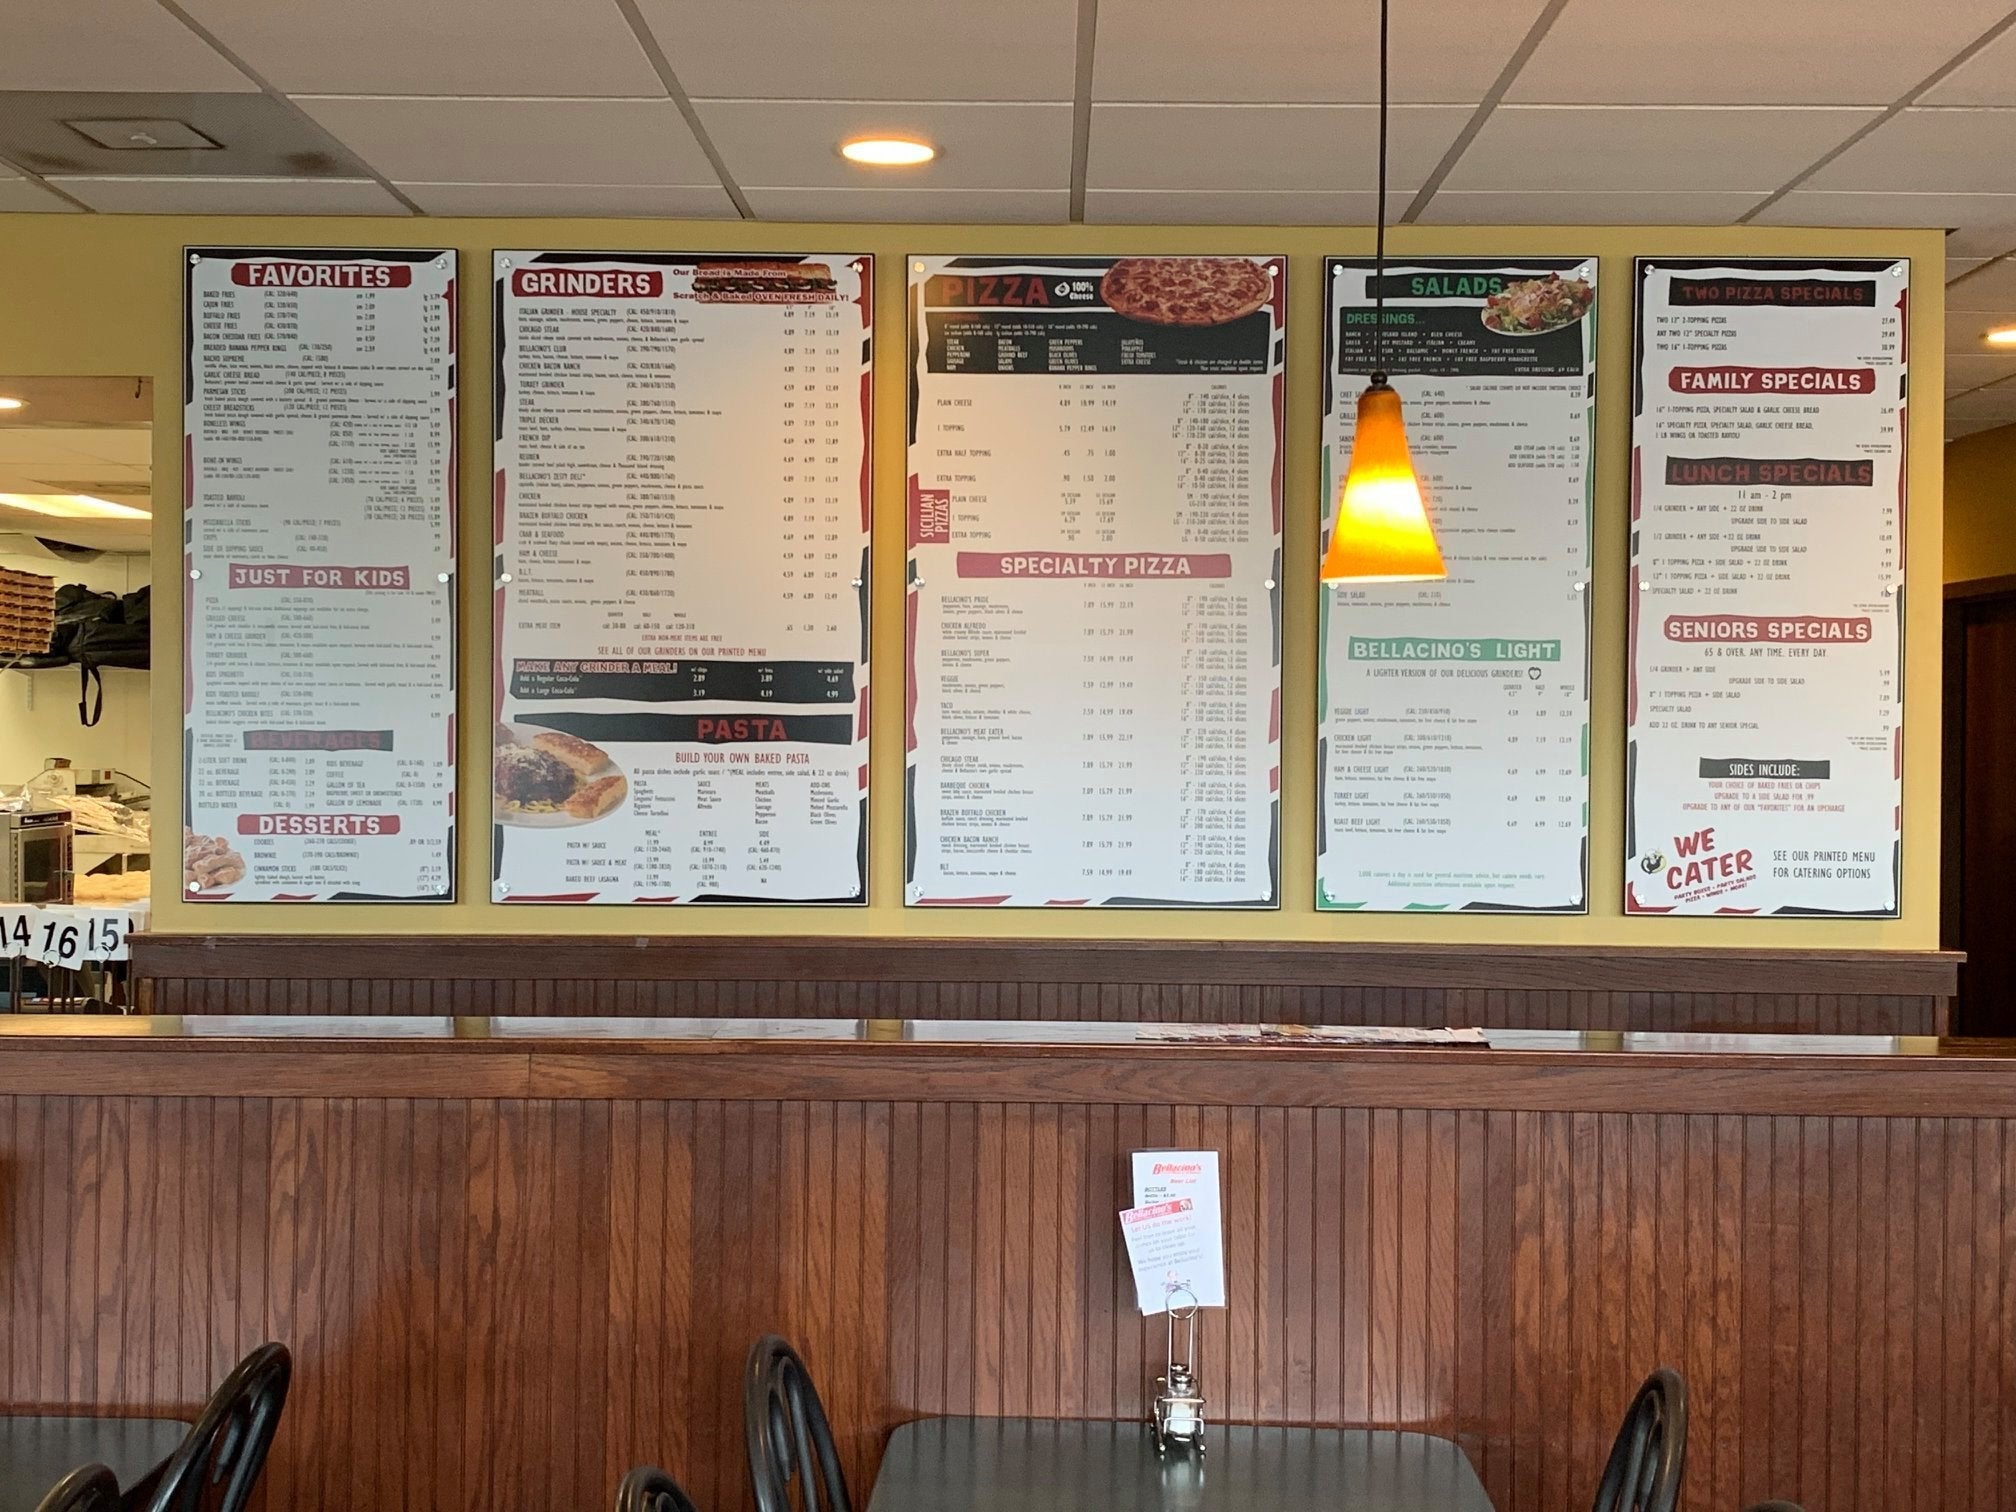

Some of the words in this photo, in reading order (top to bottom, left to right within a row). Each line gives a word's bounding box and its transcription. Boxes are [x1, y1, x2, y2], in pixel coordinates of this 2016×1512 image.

[249, 264, 390, 286] FAVORITES
[692, 269, 720, 277] Bread
[521, 273, 650, 294] GRINDERS
[1071, 282, 1094, 293] 100%
[1411, 277, 1502, 295] SALADS
[203, 291, 220, 299] BAKED
[221, 291, 235, 299] FRIES
[673, 292, 709, 300] Scratch
[712, 292, 720, 300] &
[722, 292, 752, 300] Baked
[783, 293, 814, 301] FRESH
[817, 294, 849, 302] DAILY!
[940, 277, 1049, 305] PIZZA
[1069, 292, 1094, 300] Cheese
[1682, 286, 1720, 299] TWO
[1725, 286, 1773, 300] PIZZA
[1780, 286, 1864, 301] SPECIALS
[203, 301, 220, 309] CAJUN
[221, 301, 234, 309] FRIES
[203, 322, 222, 330] CHEESE
[224, 322, 237, 330] FRIES
[247, 333, 261, 341] FRIES
[223, 371, 241, 379] CHEESE
[243, 371, 260, 379] BREAD
[1681, 373, 1754, 389] FAMILY
[1761, 373, 1861, 390] SPECIALS
[1672, 463, 1749, 481] LUNCH
[1759, 464, 1871, 483] SPECIALS
[1738, 490, 1746, 499] 11
[1772, 490, 1777, 499] 2
[1780, 492, 1792, 501] pm
[920, 493, 934, 538] SICILIAN
[934, 498, 948, 533] PIZZAS
[1000, 557, 1118, 575] SPECIALTY
[1125, 558, 1191, 575] PIZZA
[235, 568, 290, 585] JUST
[303, 569, 343, 586] FOR
[355, 570, 404, 586] KIDS
[1669, 621, 1758, 638] SENIORS
[1768, 622, 1868, 639] SPECIALS
[598, 646, 609, 656] SEE
[612, 646, 624, 656] ALL
[626, 646, 634, 656] OF
[637, 646, 651, 657] OUR
[653, 646, 686, 657] GRINDERS
[689, 647, 698, 657] ON
[701, 647, 715, 657] OUR
[718, 647, 745, 657] PRINTED
[748, 648, 767, 657] MENU
[1353, 642, 1482, 658] BELLACINO'S
[1496, 642, 1555, 659] LIGHT
[1704, 648, 1714, 657] 65
[1717, 648, 1722, 657] &
[1750, 648, 1763, 657] ANY
[1788, 648, 1809, 657] EVERY
[515, 661, 550, 673] MAKE
[553, 661, 579, 673] ANY
[581, 662, 629, 674] GRINDER
[630, 663, 641, 673] A
[642, 663, 678, 674] MEAL!
[1366, 668, 1371, 677] A
[1373, 668, 1399, 678] LIGHTER
[1401, 668, 1427, 678] VERSION
[1429, 668, 1437, 678] OF
[1440, 668, 1454, 678] OUR
[1457, 668, 1489, 678] DELICIOUS
[1491, 669, 1523, 678] GRINDERS!
[697, 719, 787, 740] PASTA
[675, 752, 700, 764] BUILD
[703, 753, 726, 764] YOUR
[729, 753, 750, 764] OWN
[754, 753, 782, 764] BAKED
[786, 753, 810, 764] PASTA
[1729, 763, 1754, 776] SIDES
[1758, 764, 1800, 776] INCLUDE:
[940, 782, 967, 790] BARBEQUE
[968, 782, 990, 790] CHICKEN
[1708, 781, 1723, 789] YOUR
[1725, 781, 1744, 789] CHOICE
[1795, 782, 1803, 790] OR
[1805, 782, 1821, 790] CHIPS
[1714, 792, 1739, 800] UPGRADE
[1742, 792, 1750, 800] TO
[1773, 793, 1790, 801] SALAD
[1792, 793, 1803, 801] FOR
[259, 816, 380, 834] DESSERTS
[1673, 827, 1715, 858] WE
[1773, 850, 1788, 861] SEE
[1791, 850, 1809, 862] OUR
[1813, 851, 1848, 862] PRINTED
[1852, 851, 1876, 862] MENU
[1666, 849, 1753, 890] CATER
[1773, 868, 1789, 878] FOR
[1793, 868, 1832, 879] CATERING
[1836, 868, 1871, 879] OPTIONS
[0, 915, 31, 949] 14
[88, 918, 119, 952] 15
[43, 921, 79, 959] 16
[1153, 1163, 1202, 1175] Bellacino's
[1124, 1203, 1173, 1225] Bellacino's
